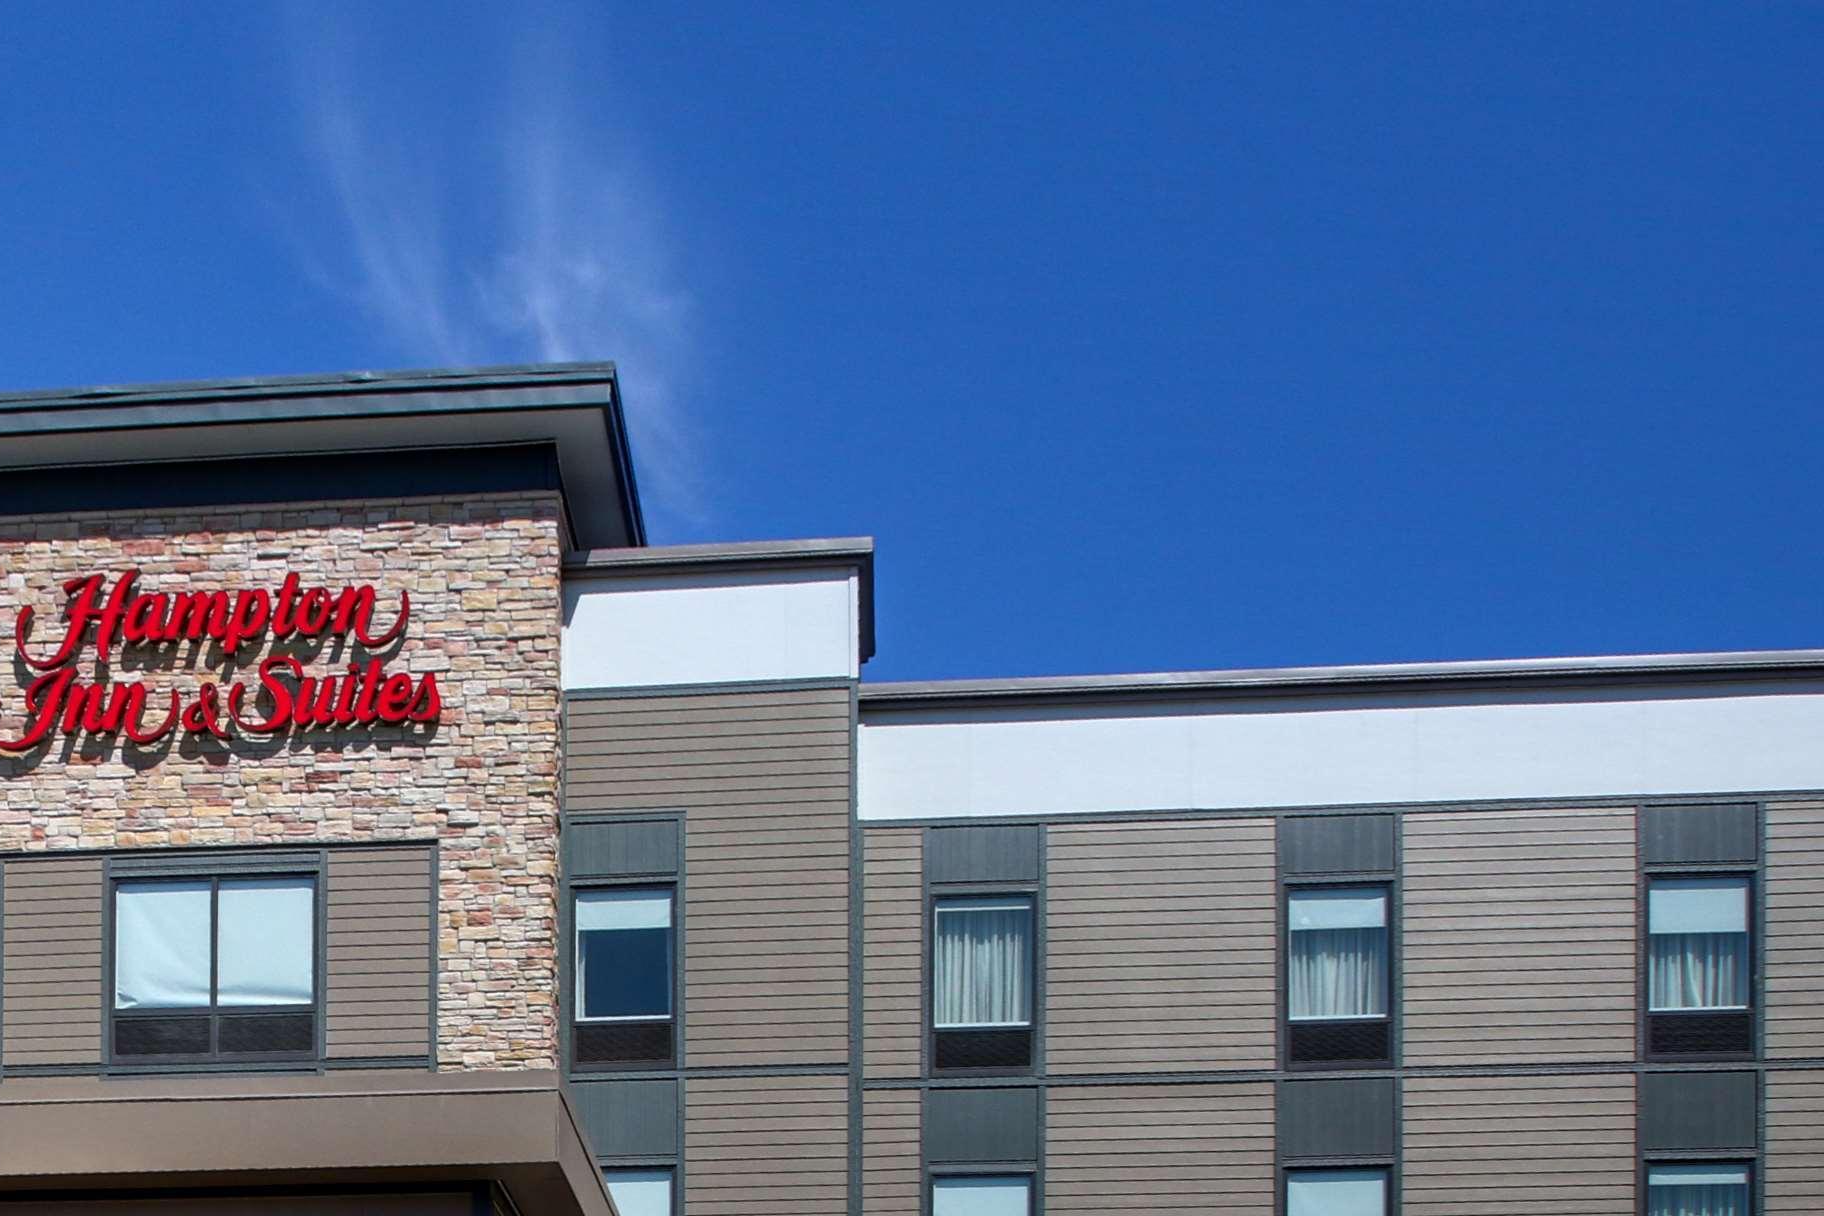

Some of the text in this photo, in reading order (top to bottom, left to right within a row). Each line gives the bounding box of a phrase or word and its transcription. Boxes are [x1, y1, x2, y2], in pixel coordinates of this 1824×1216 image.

[16, 568, 409, 672] Hampton
[182, 681, 232, 740] &
[228, 655, 442, 734] Suites
